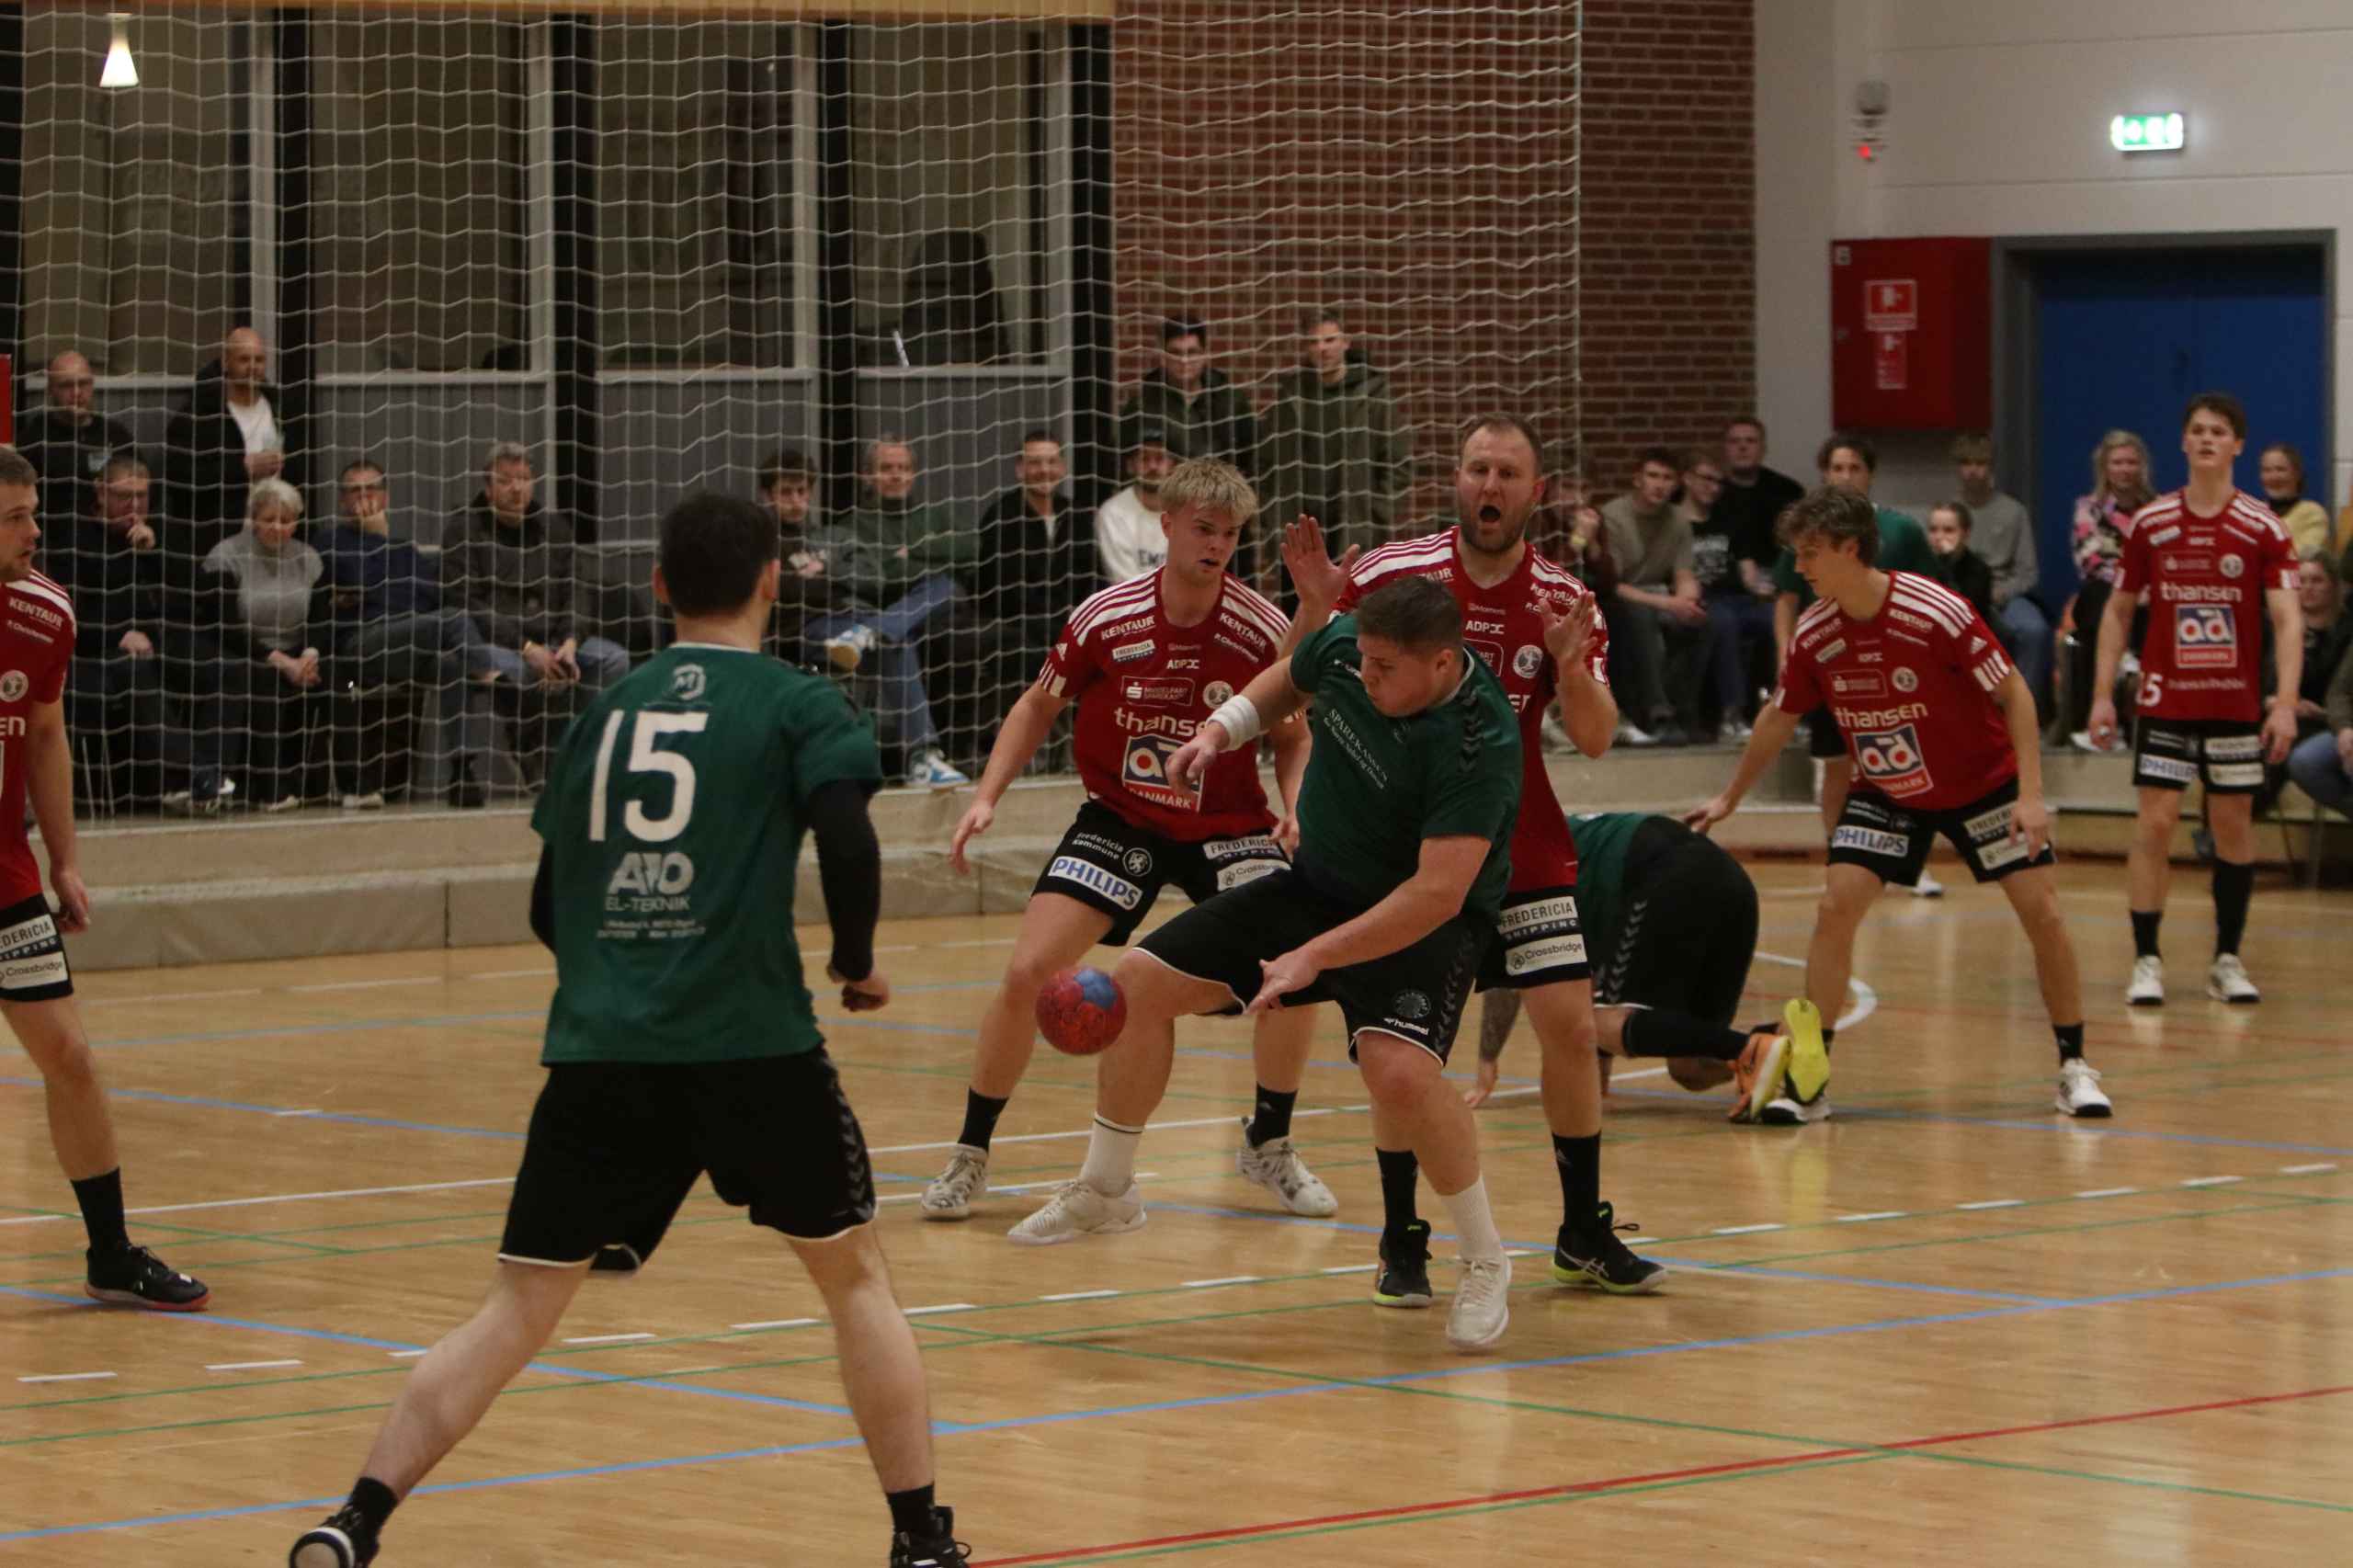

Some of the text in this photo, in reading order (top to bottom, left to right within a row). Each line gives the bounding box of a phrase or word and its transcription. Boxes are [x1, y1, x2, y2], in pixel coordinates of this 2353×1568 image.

[8, 597, 63, 628] KENTAUR
[1101, 616, 1155, 641] KENTAUR
[1220, 613, 1267, 649] KENTAUR
[1114, 707, 1207, 737] thanse
[1835, 703, 1928, 728] thansen
[589, 710, 710, 843] 15
[1837, 828, 1906, 854] PHILIPS
[1052, 858, 1140, 906] PHILIPS
[605, 897, 691, 913] EL-TEKNIK
[1500, 902, 1574, 928] FREDERICIA
[1505, 919, 1577, 940] SHIPPING
[1525, 941, 1582, 960] Crossbridge
[6, 960, 63, 976] Crossbridge
[1394, 1018, 1430, 1036] hummel
